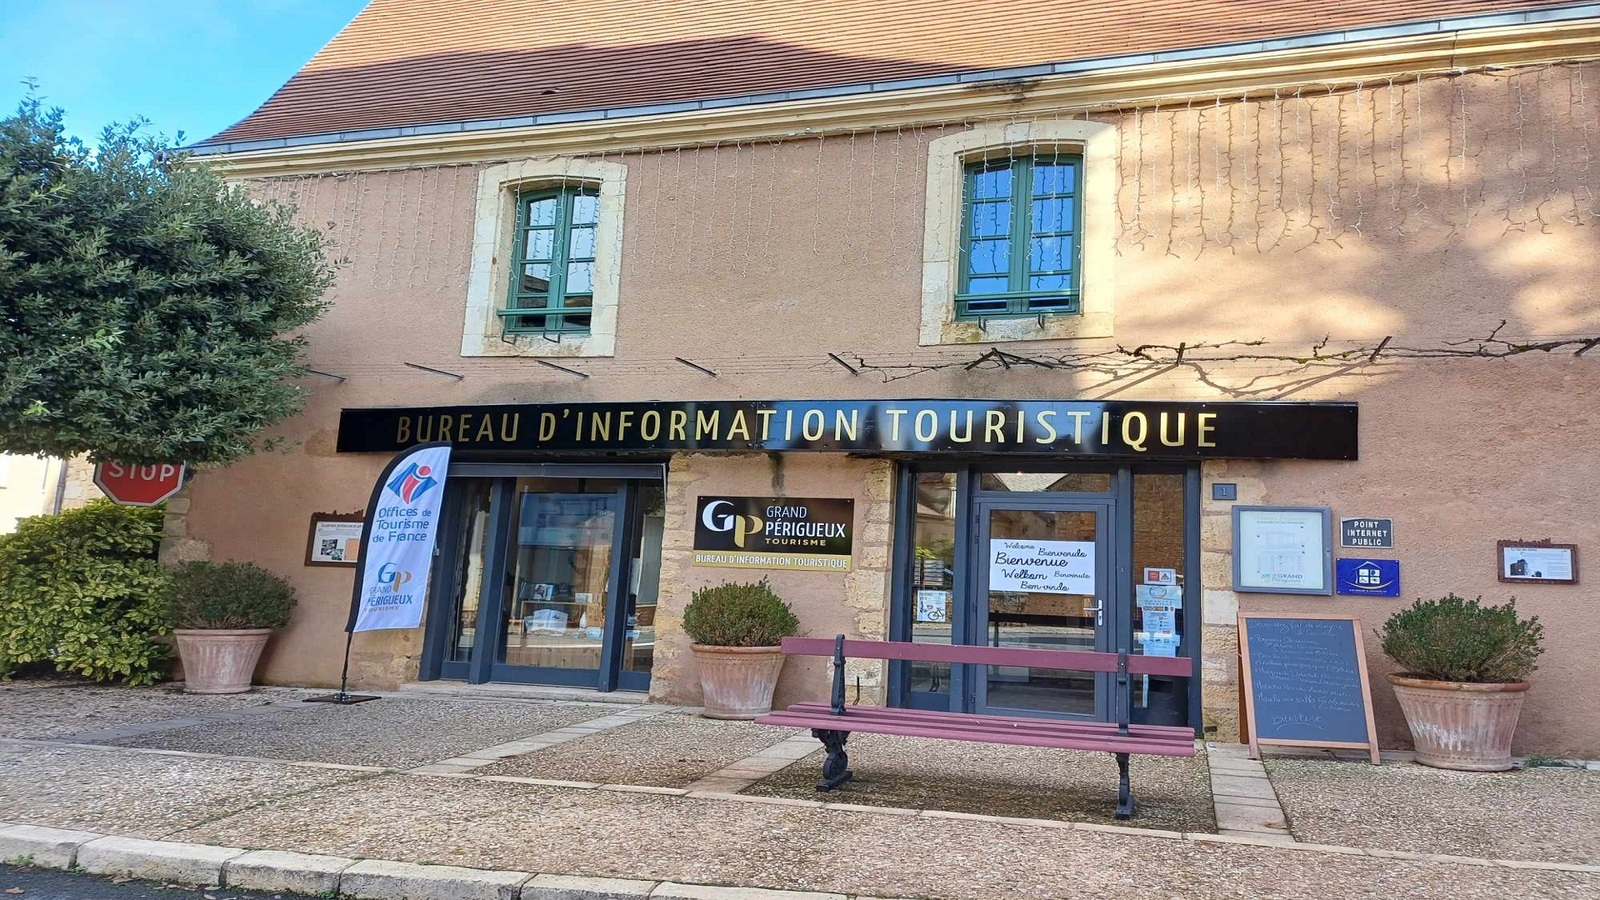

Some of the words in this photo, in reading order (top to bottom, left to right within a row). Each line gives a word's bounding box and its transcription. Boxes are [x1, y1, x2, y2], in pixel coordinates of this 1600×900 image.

[397, 413, 520, 443] BUREAU
[539, 409, 858, 441] D'INFORMATION
[886, 409, 1217, 452] TOURISTIQUE
[108, 461, 175, 482] STOP
[1220, 487, 1228, 497] 1
[378, 507, 418, 519] Offices
[422, 508, 432, 517] de
[766, 505, 807, 518] GRAND
[377, 518, 430, 531] Tourisme
[765, 518, 846, 538] PÉRIGUEUX
[1354, 521, 1379, 529] POINT
[372, 534, 385, 543] de
[388, 531, 427, 542] France
[1347, 529, 1388, 538] INTERNET
[765, 538, 827, 546] TOURISME
[1352, 538, 1382, 546] PUBLIC
[695, 554, 727, 564] BUREAU
[729, 555, 791, 566] D'INFORMATION
[793, 558, 847, 568] TOURISTIQUE
[994, 551, 1069, 568] Bienvenue
[1001, 568, 1048, 580] Welkom
